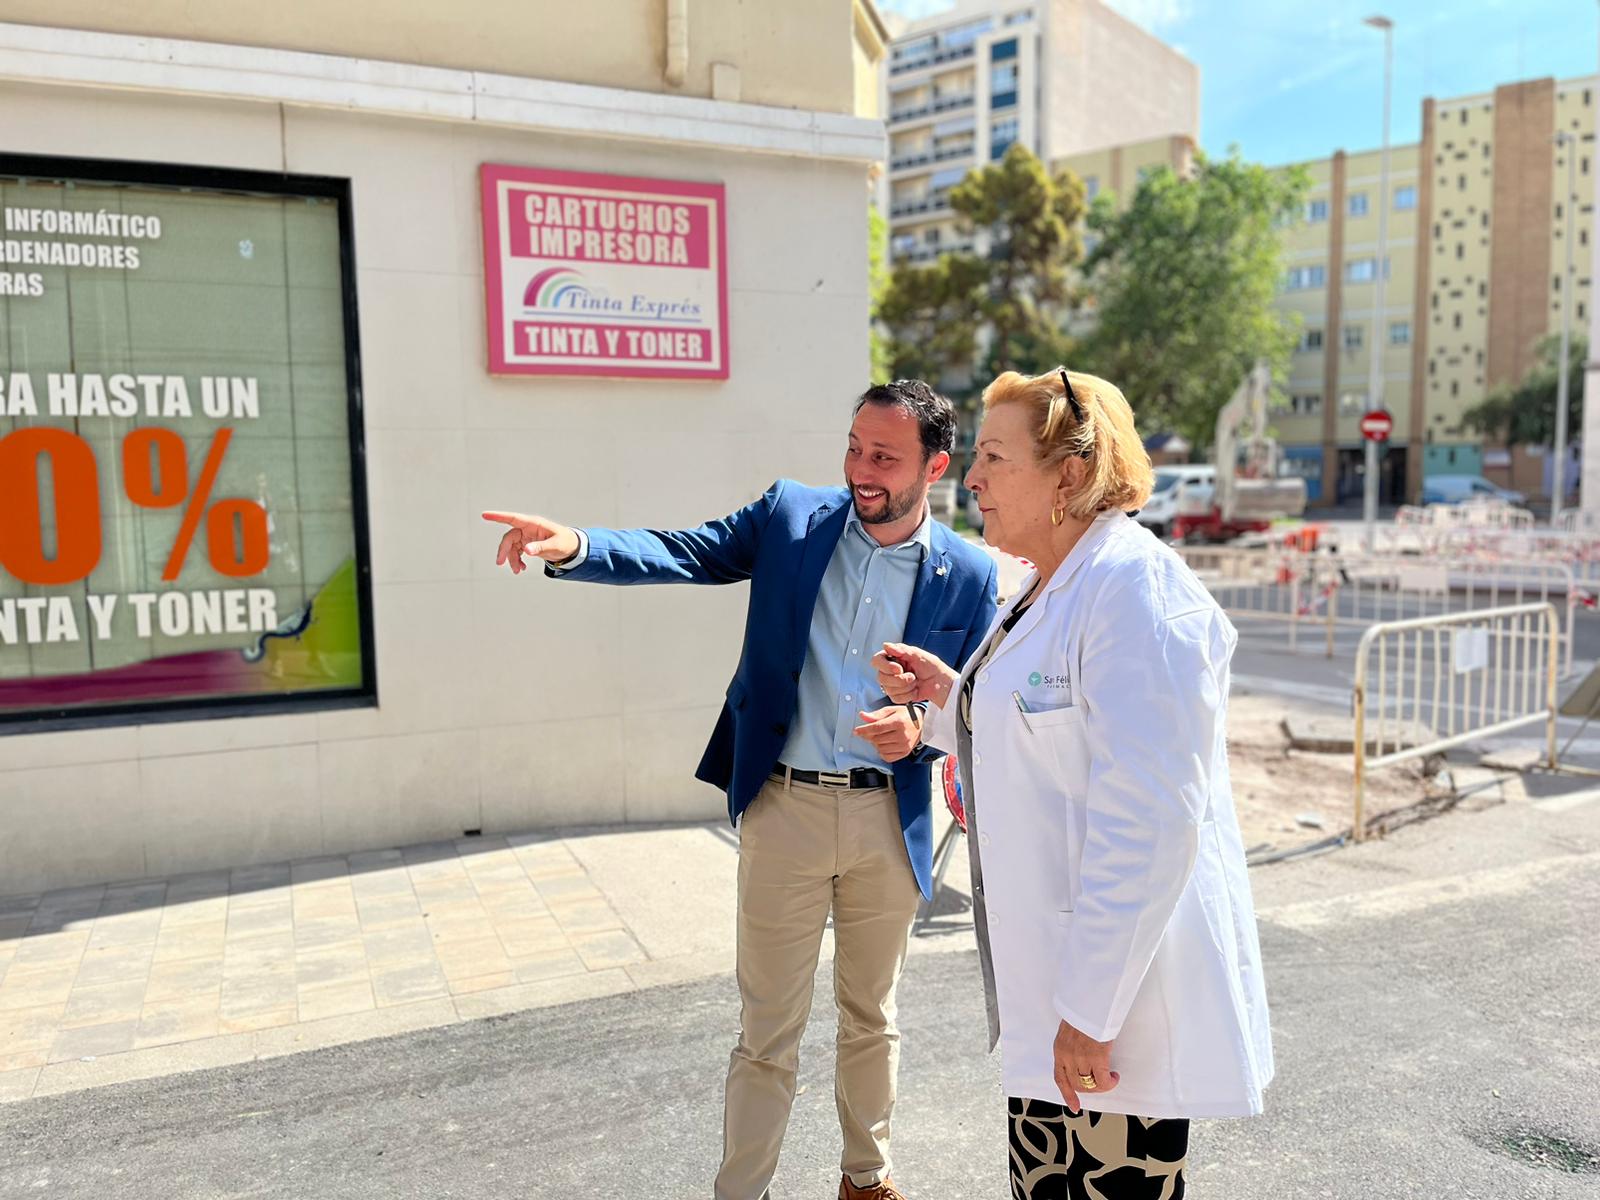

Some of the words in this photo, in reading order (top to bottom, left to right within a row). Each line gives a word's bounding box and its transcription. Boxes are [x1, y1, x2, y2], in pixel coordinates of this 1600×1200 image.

[5, 207, 162, 239] INFORMÁTICO
[524, 194, 691, 235] CARTUCHOS
[529, 226, 689, 265] IMPRESORA
[0, 272, 44, 296] RAS
[566, 291, 623, 312] Tinta
[631, 294, 702, 319] Exprés
[525, 326, 599, 356] TINTA
[604, 329, 620, 357] Y
[626, 331, 703, 359] TONER
[0, 373, 38, 416] A
[48, 373, 192, 417] HASTA
[201, 376, 260, 418] UN
[0, 427, 270, 585] 0%
[87, 594, 118, 641] Y
[129, 588, 278, 638] TONER
